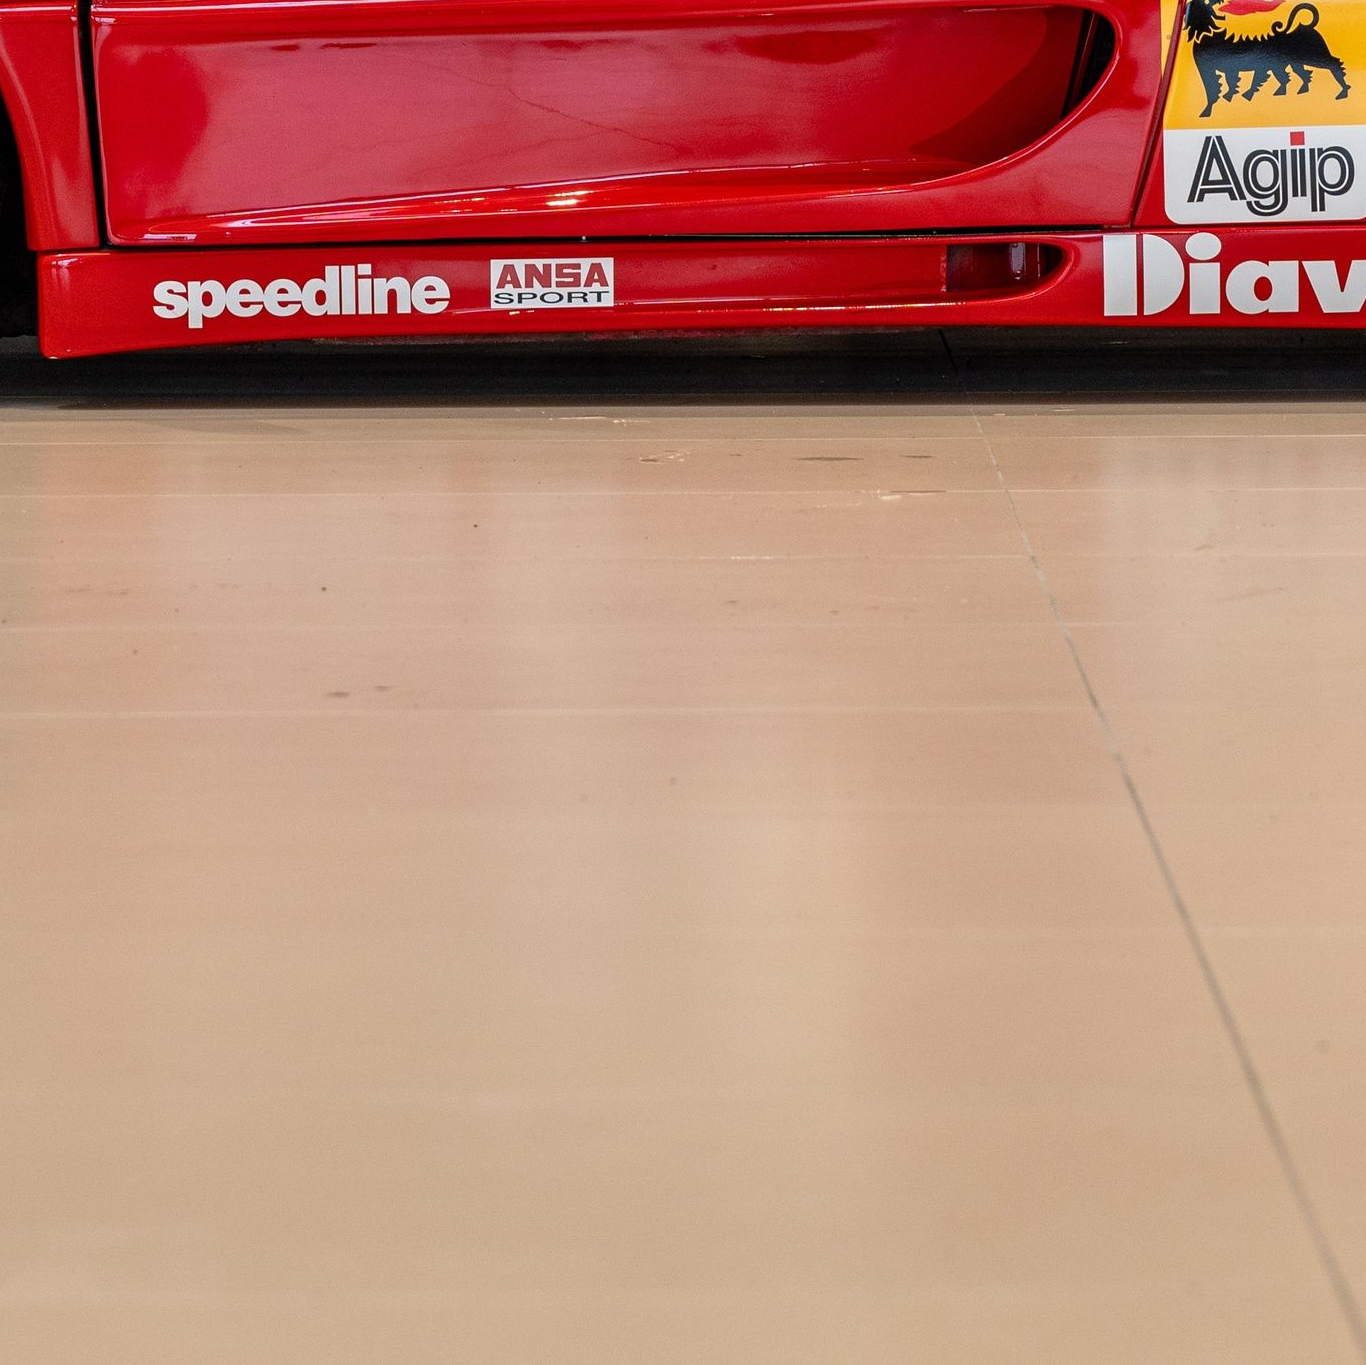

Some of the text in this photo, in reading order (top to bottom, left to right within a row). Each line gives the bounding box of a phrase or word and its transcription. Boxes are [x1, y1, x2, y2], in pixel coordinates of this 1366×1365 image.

[1186, 130, 1356, 217] Agip
[152, 263, 451, 329] speedline
[493, 290, 610, 305] SPORT
[495, 261, 610, 289] ANSA
